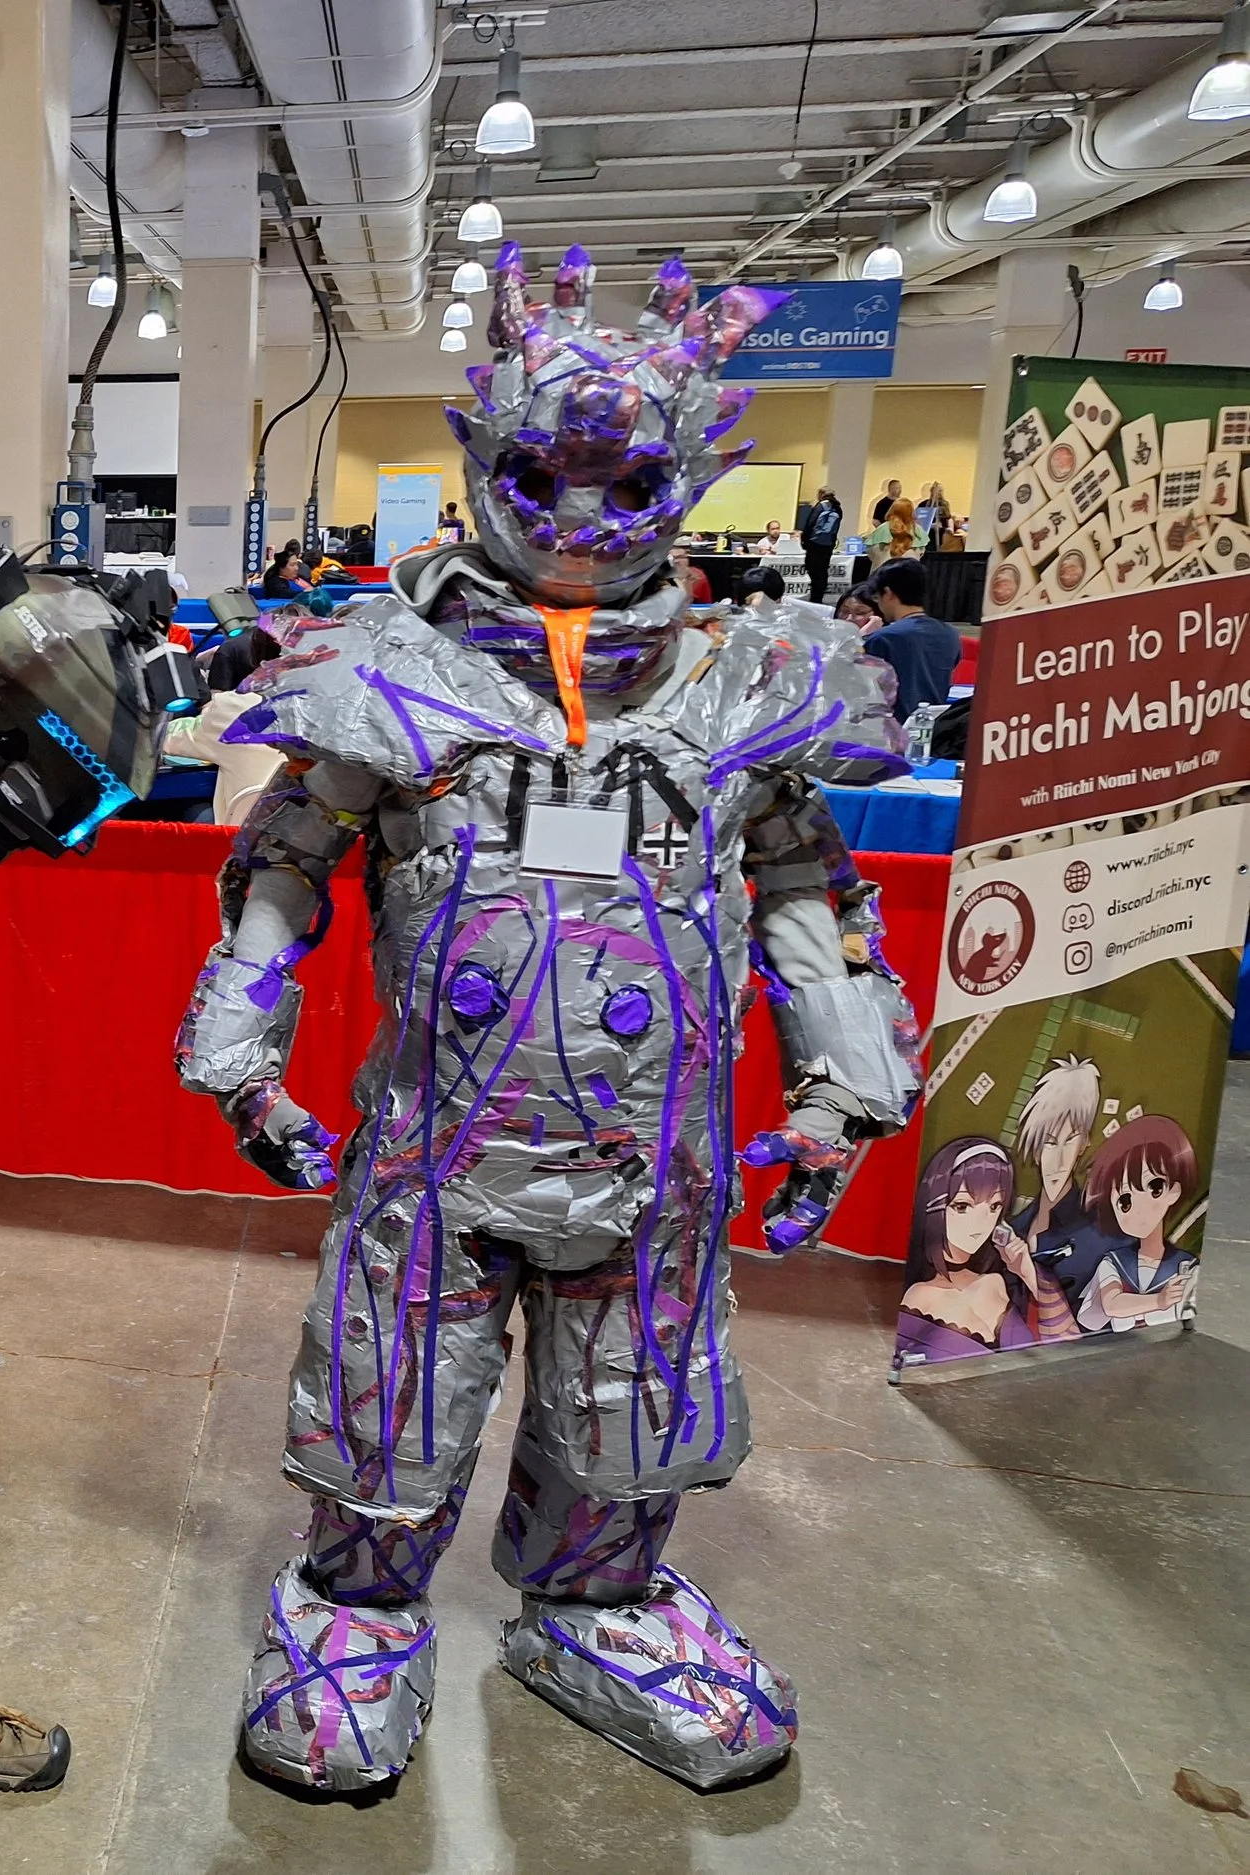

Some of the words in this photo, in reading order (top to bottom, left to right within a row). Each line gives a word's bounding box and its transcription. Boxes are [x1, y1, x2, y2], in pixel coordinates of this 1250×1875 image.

[800, 326, 890, 349] Gaming
[1126, 351, 1166, 363] EXIT
[401, 497, 426, 506] Gaming
[1016, 638, 1115, 686] Learn
[1127, 624, 1164, 663] to
[1178, 602, 1250, 656] Play
[981, 701, 1091, 766] Riichi
[1020, 786, 1050, 807] with
[1053, 777, 1095, 801] Riichi
[1098, 768, 1137, 791] Nomi
[1141, 765, 1174, 783] New
[1174, 755, 1200, 776] York
[1201, 749, 1222, 766] City
[1105, 838, 1195, 874] www.riichi.nyc
[962, 885, 993, 913] RIICHI
[994, 884, 1021, 900] NOMI
[1107, 875, 1212, 916] discord.riichi.nyc
[1105, 915, 1194, 958] @nycriichinomi
[957, 973, 976, 992] NEW
[976, 979, 1002, 993] YORK
[1002, 959, 1022, 983] CITY
